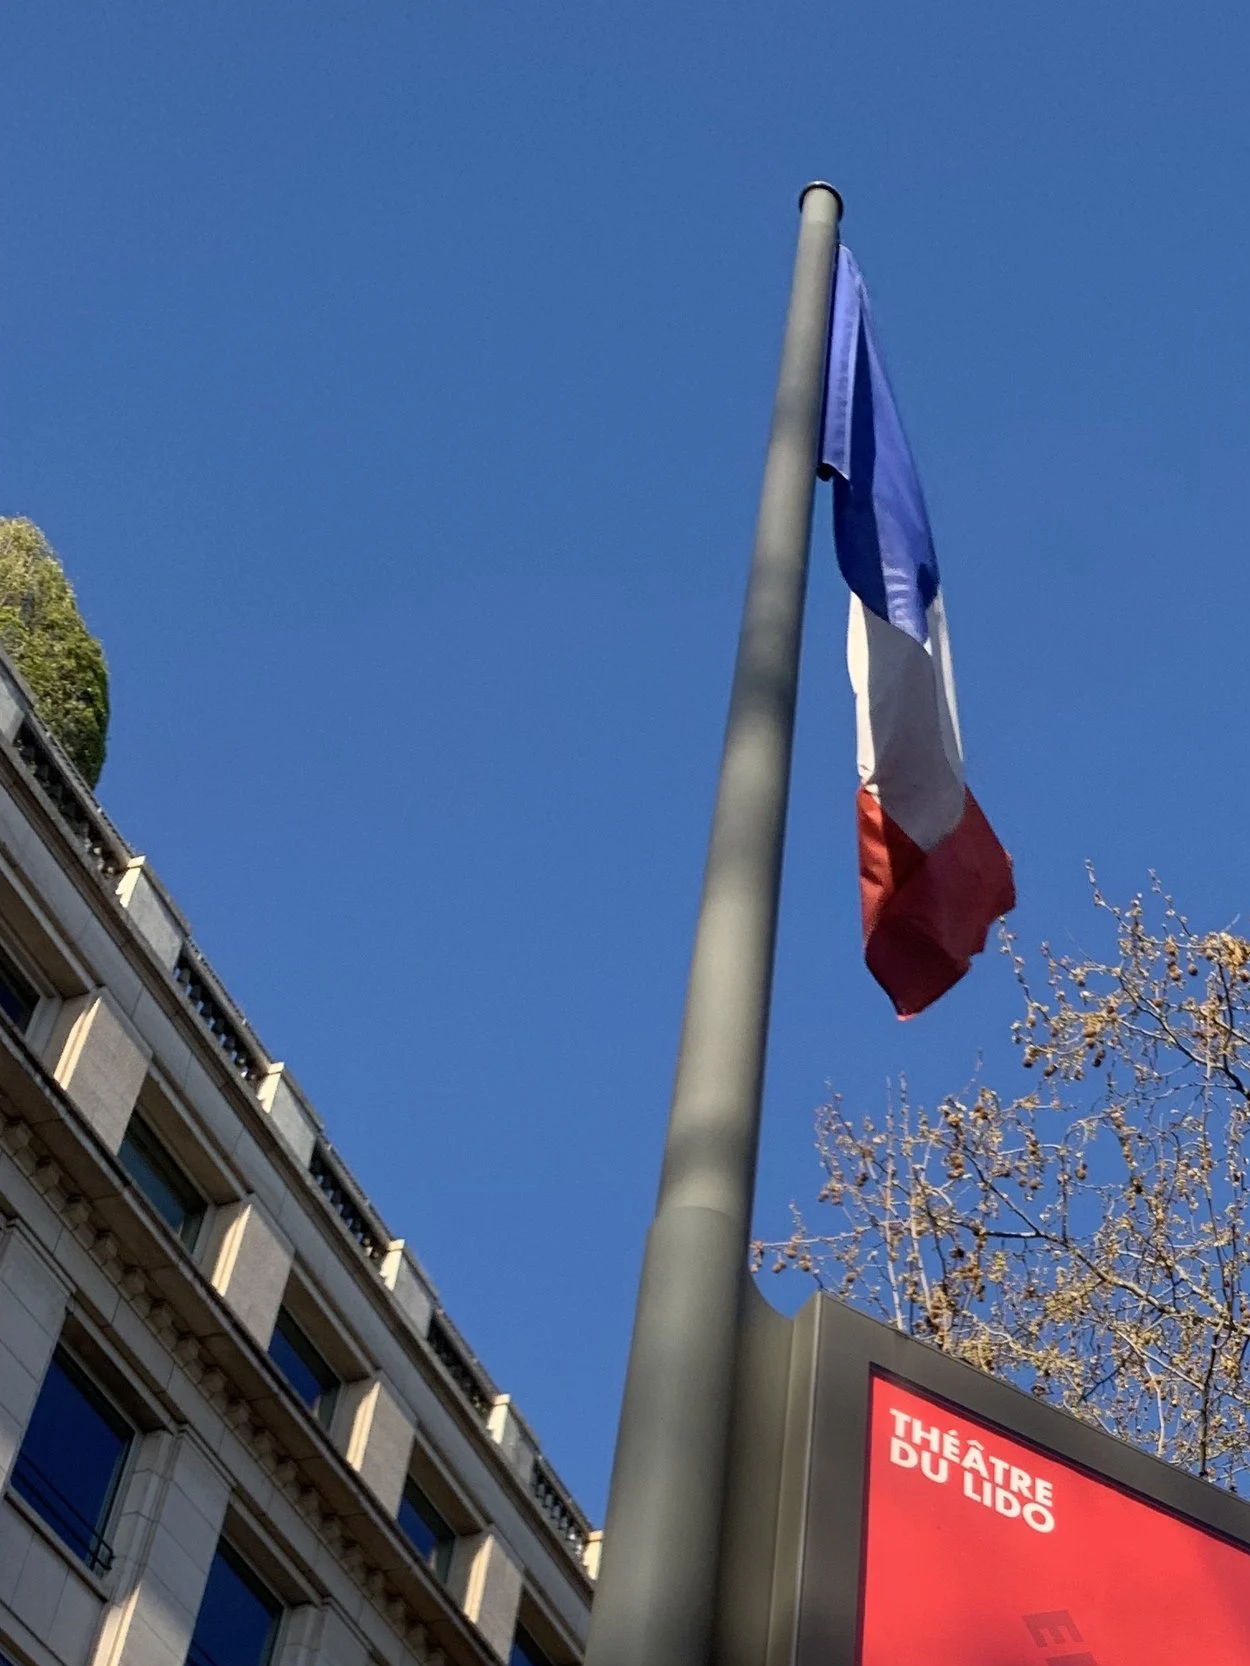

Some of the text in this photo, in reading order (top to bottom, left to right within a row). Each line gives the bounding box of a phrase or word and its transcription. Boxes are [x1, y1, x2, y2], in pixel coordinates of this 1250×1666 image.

[889, 1408, 1053, 1507] THÉÂTRE
[890, 1437, 1055, 1533] DU LIDO
